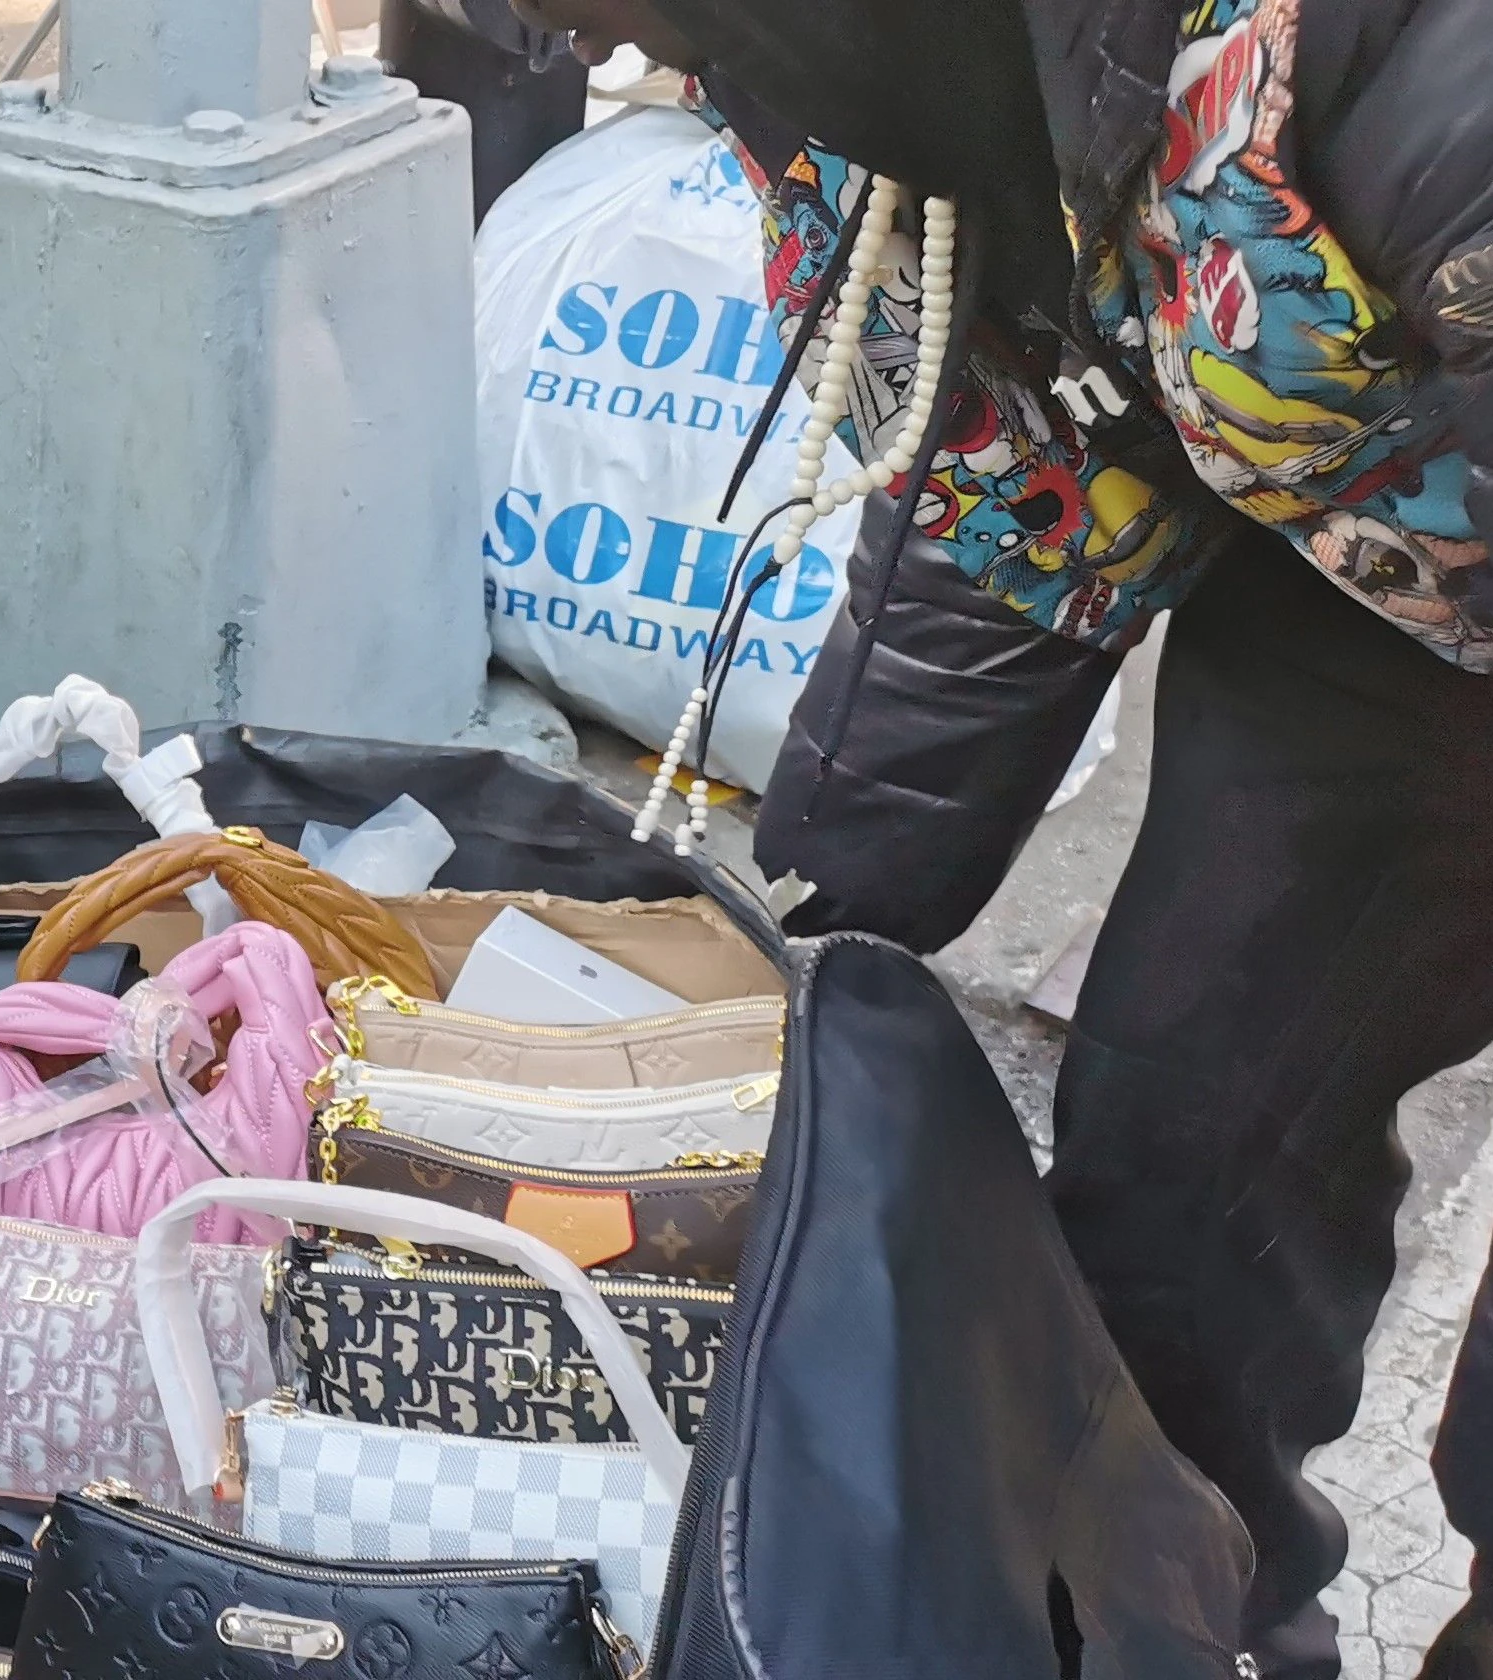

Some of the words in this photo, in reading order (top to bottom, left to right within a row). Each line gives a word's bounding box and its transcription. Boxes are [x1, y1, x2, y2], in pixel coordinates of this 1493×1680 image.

[538, 281, 786, 386] SOH
[524, 369, 812, 445] BROADW
[482, 486, 835, 623] SOHO
[18, 1275, 102, 1307] Dior
[498, 1347, 596, 1392] Dior
